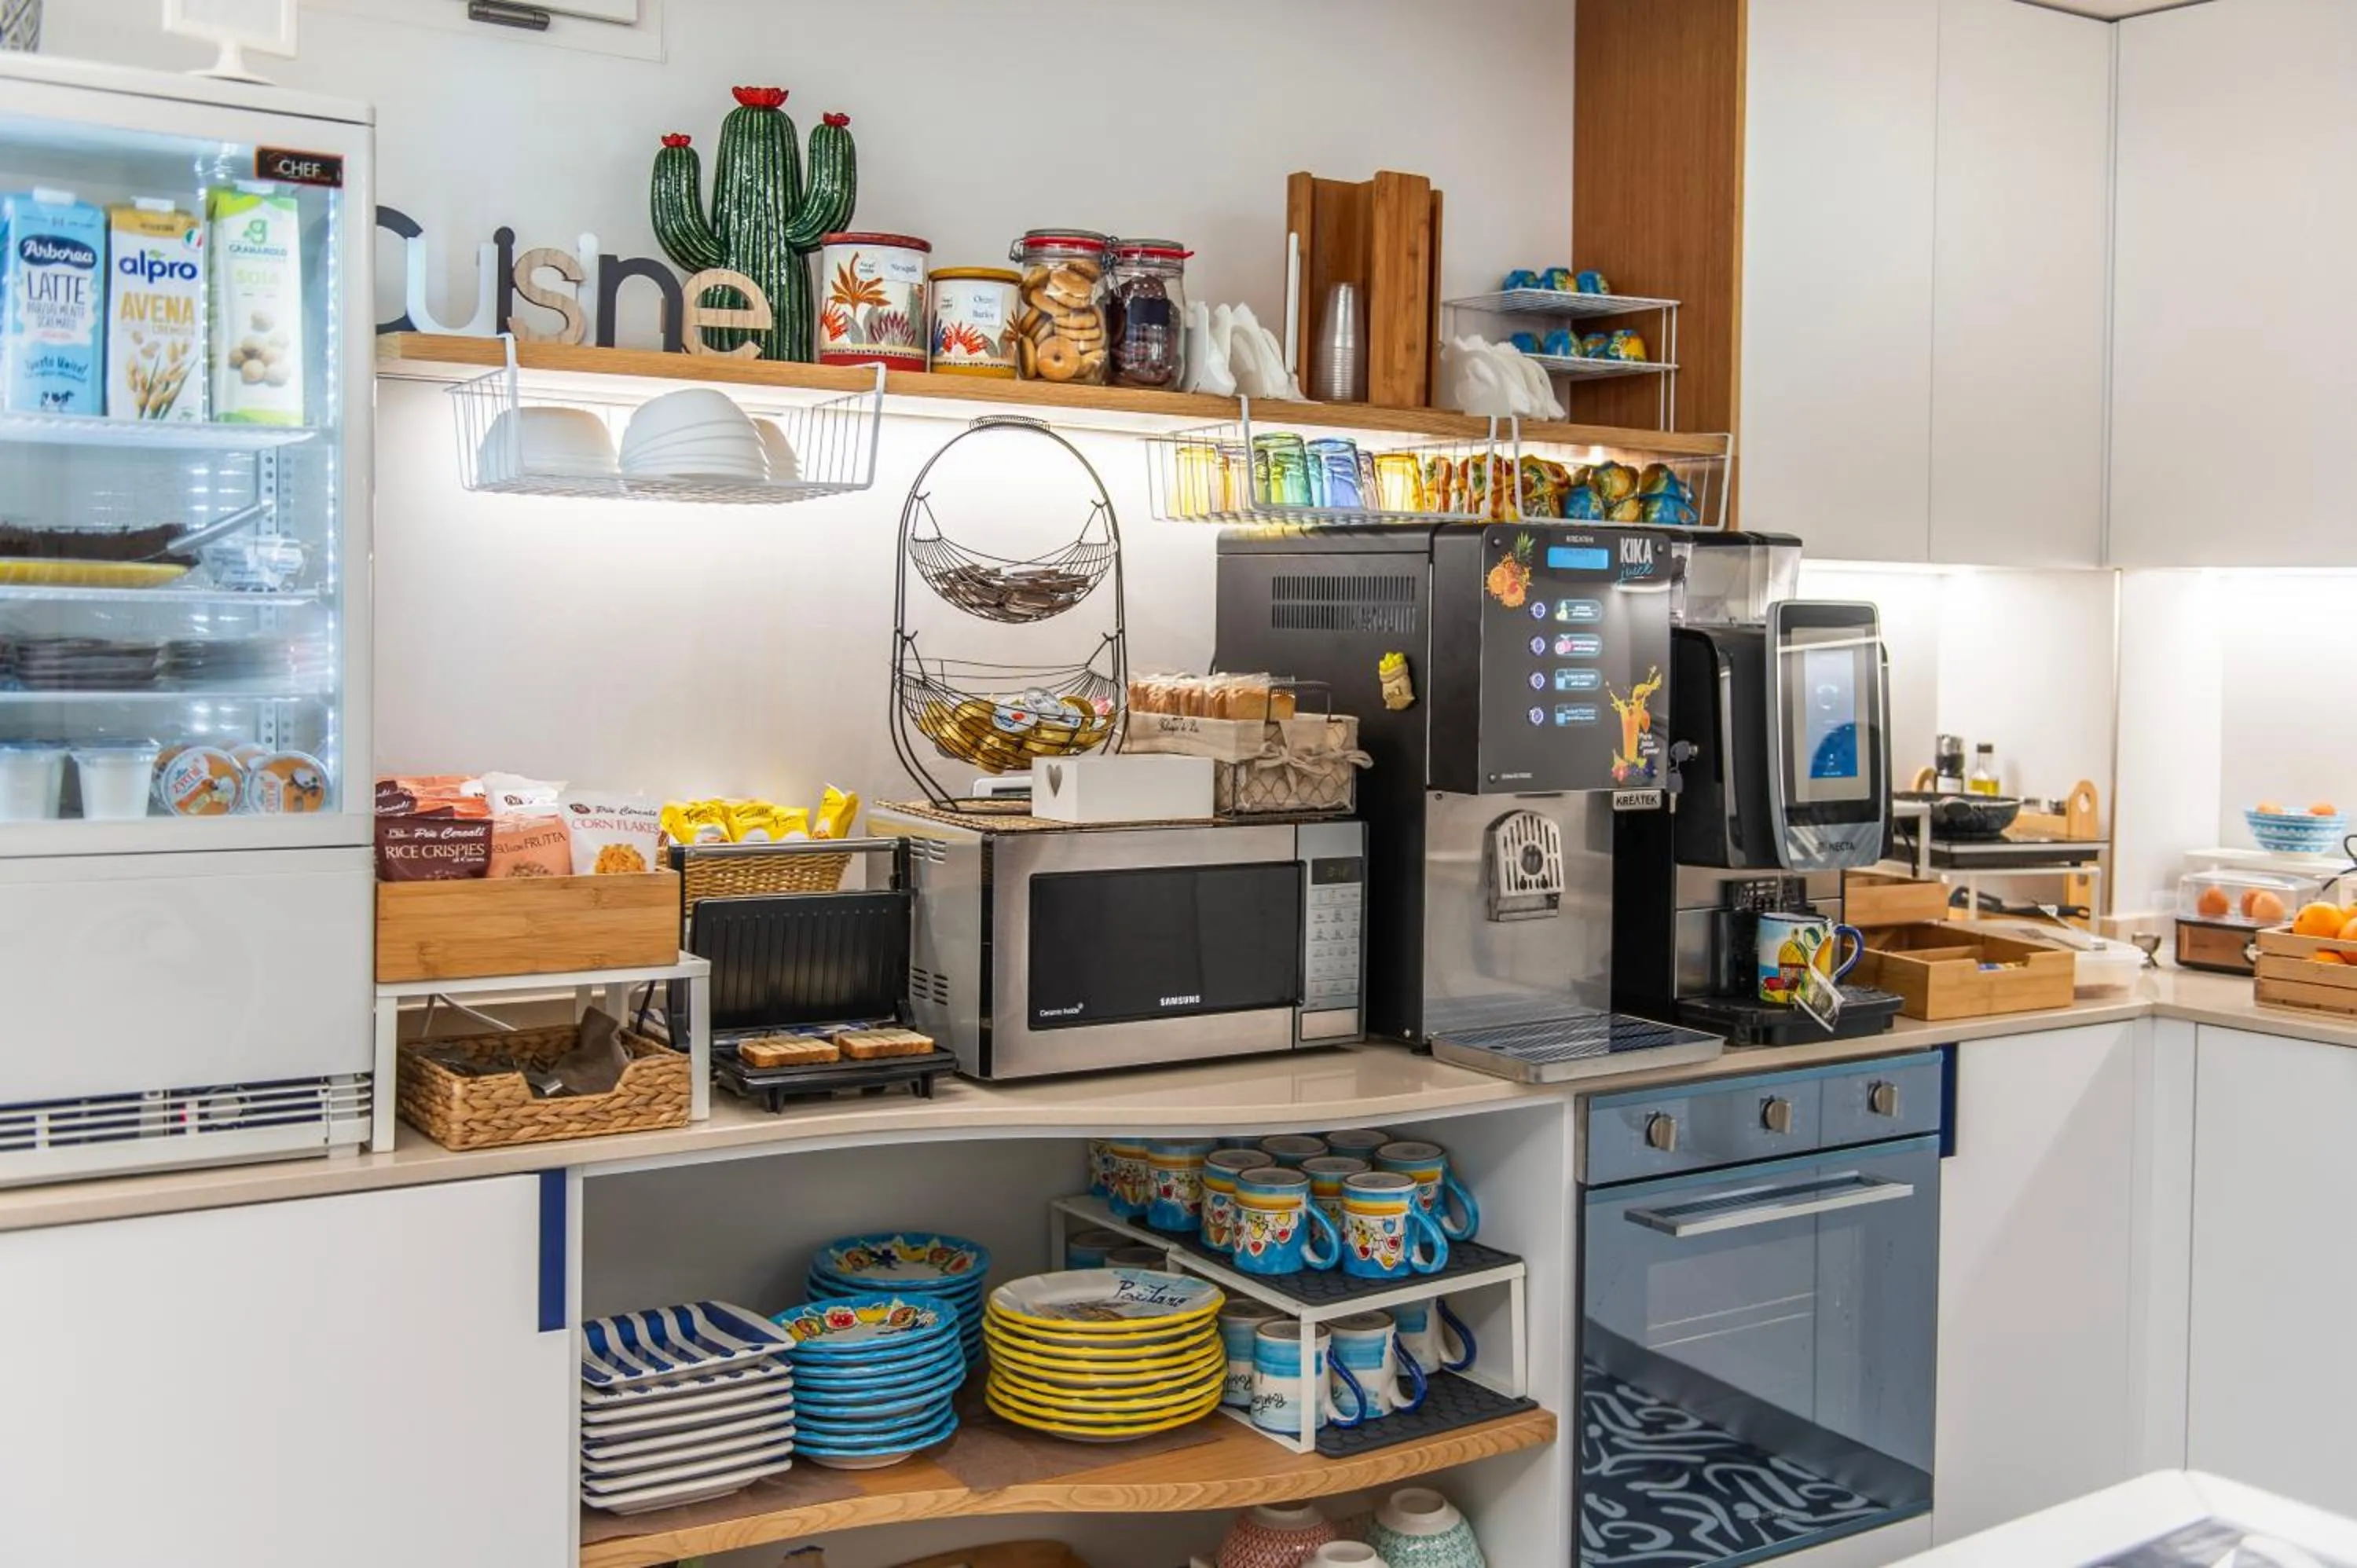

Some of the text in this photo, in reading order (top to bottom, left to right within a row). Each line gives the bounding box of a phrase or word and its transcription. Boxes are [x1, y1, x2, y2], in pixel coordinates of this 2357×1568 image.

[279, 159, 321, 178] CHEF
[24, 240, 94, 263] Arborea
[119, 248, 198, 284] alpro
[27, 270, 88, 306] LATTE
[120, 291, 195, 326] AVENA
[1619, 537, 1653, 564] KIKA
[571, 818, 659, 835] CORN FLAKES
[524, 830, 567, 849] FRUTTA
[384, 842, 486, 861] RICE CRISPIES
[1160, 995, 1200, 1007] SAMSUNG
